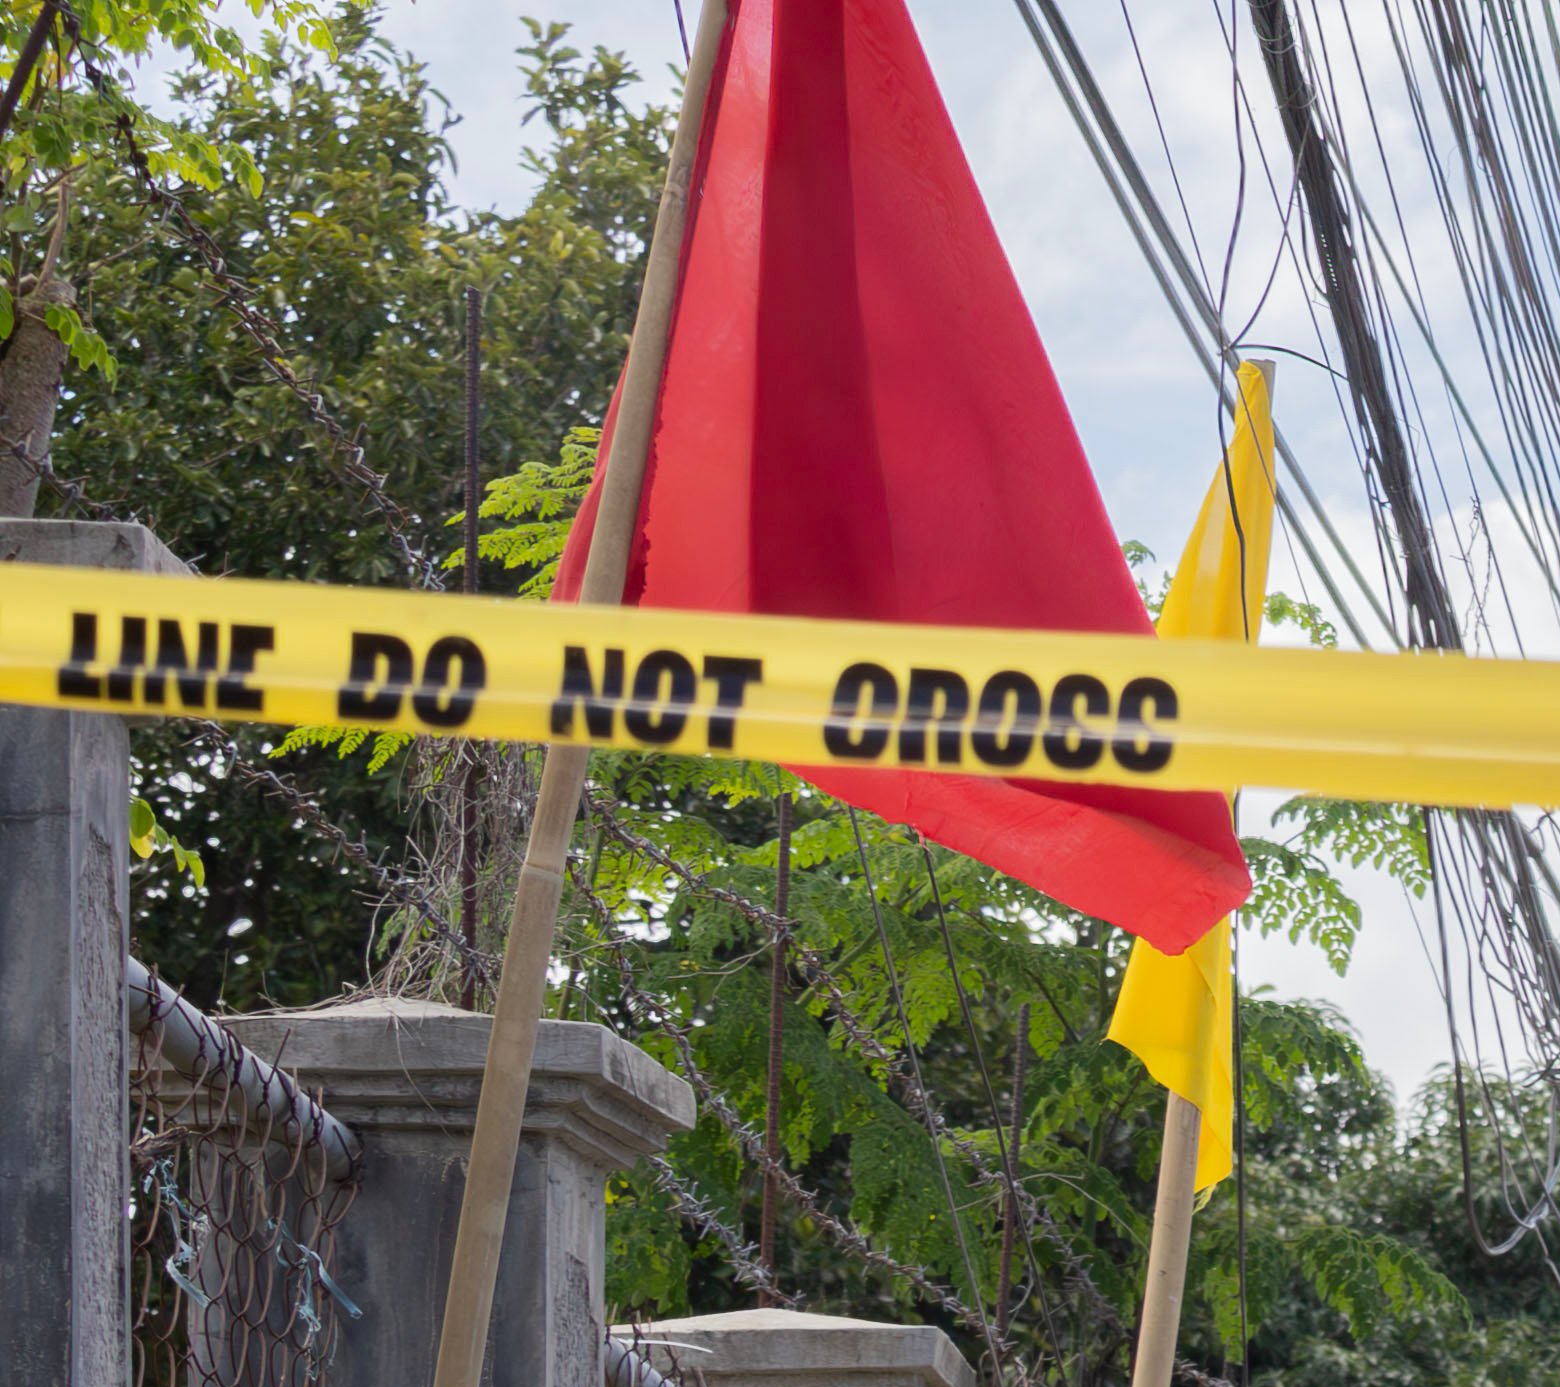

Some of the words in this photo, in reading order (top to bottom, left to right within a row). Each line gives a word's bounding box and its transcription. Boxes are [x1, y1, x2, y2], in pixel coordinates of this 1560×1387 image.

[57, 612, 275, 711] LINE
[336, 632, 487, 729] DO
[549, 645, 763, 750] NOT
[823, 662, 1178, 773] CROSS
